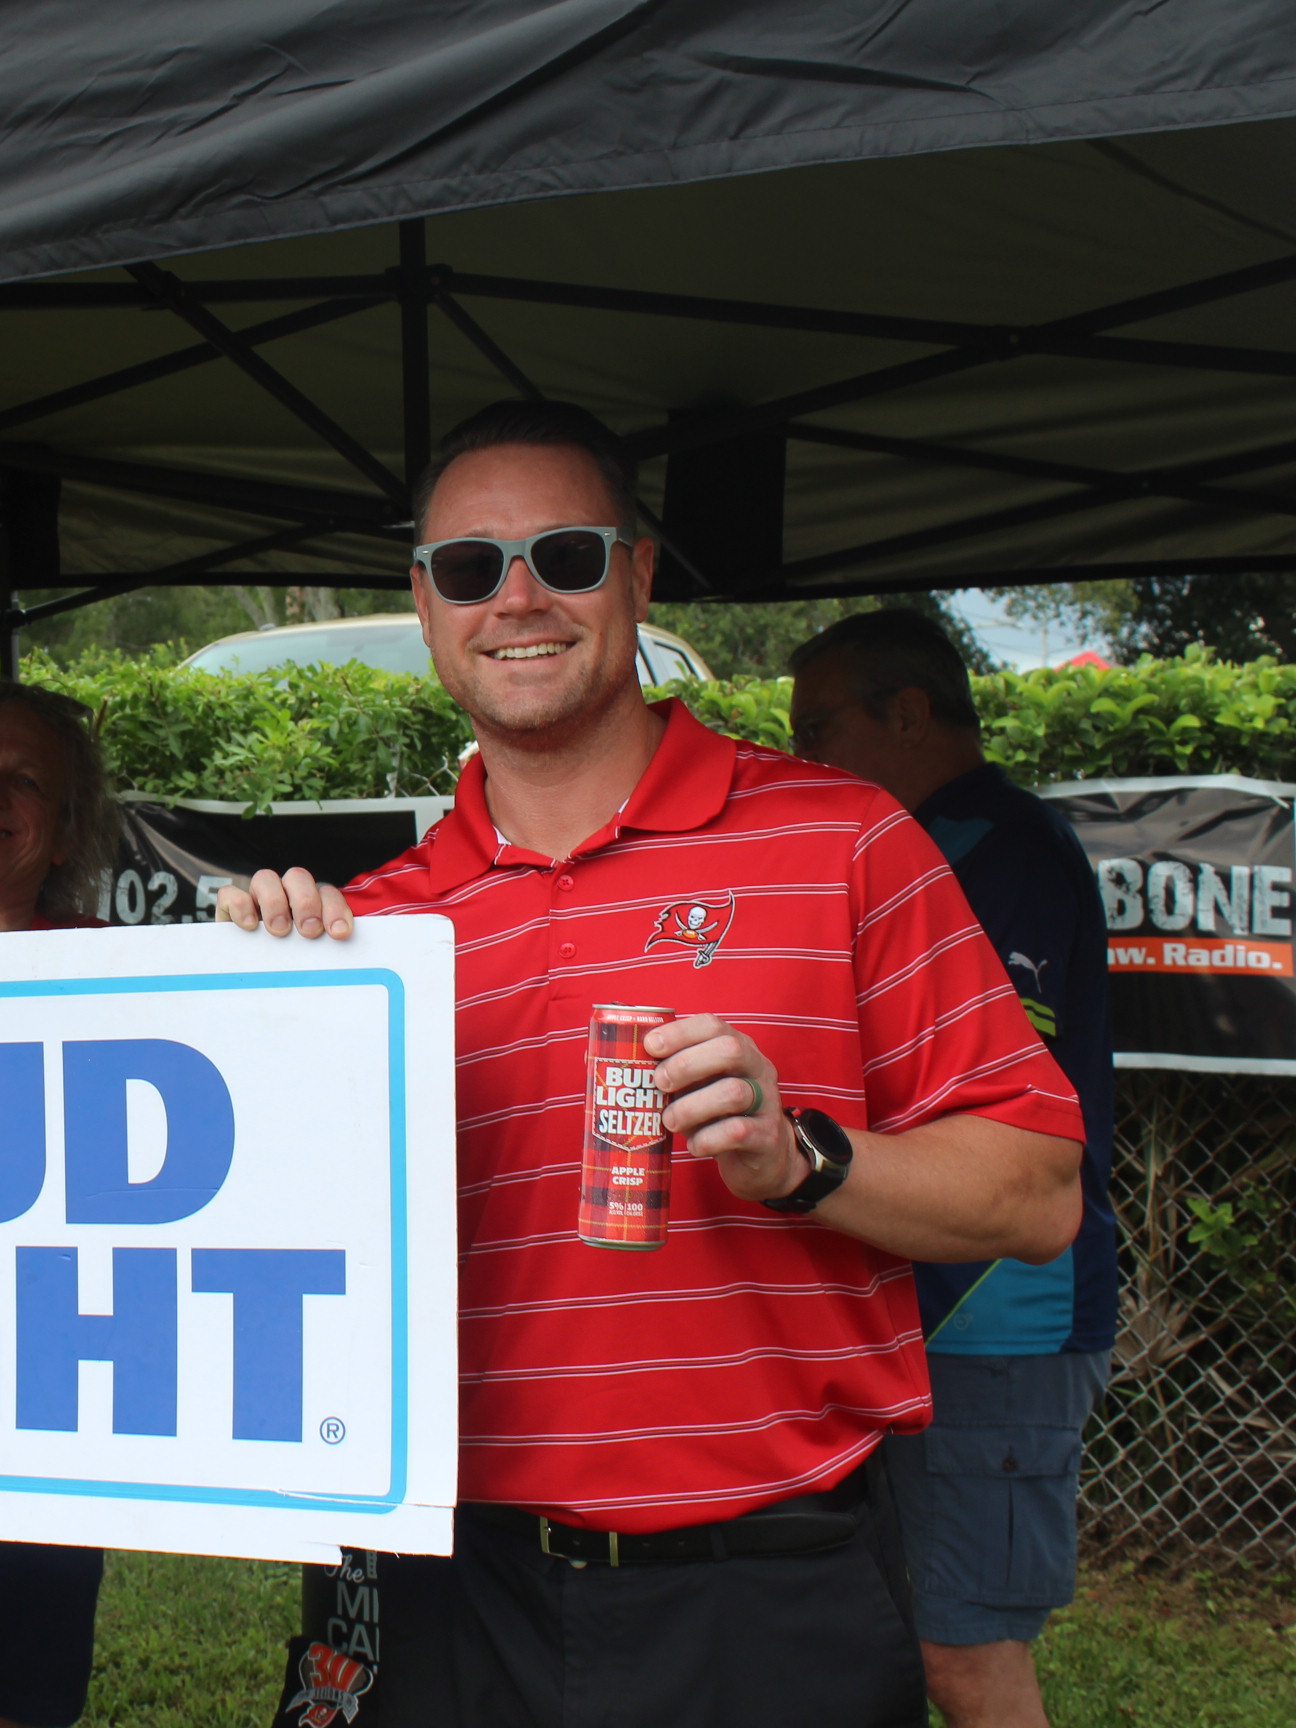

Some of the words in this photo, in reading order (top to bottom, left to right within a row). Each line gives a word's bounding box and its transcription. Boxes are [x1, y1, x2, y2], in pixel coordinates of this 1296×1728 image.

[1097, 858, 1292, 937] BONE
[1162, 943, 1283, 970] Radio.
[605, 1066, 656, 1089] BUD
[596, 1087, 666, 1109] LIGHT
[611, 1166, 645, 1176] APPLE
[612, 1176, 644, 1186] CRISP
[609, 1201, 623, 1210] 5%
[627, 1203, 643, 1211] 100
